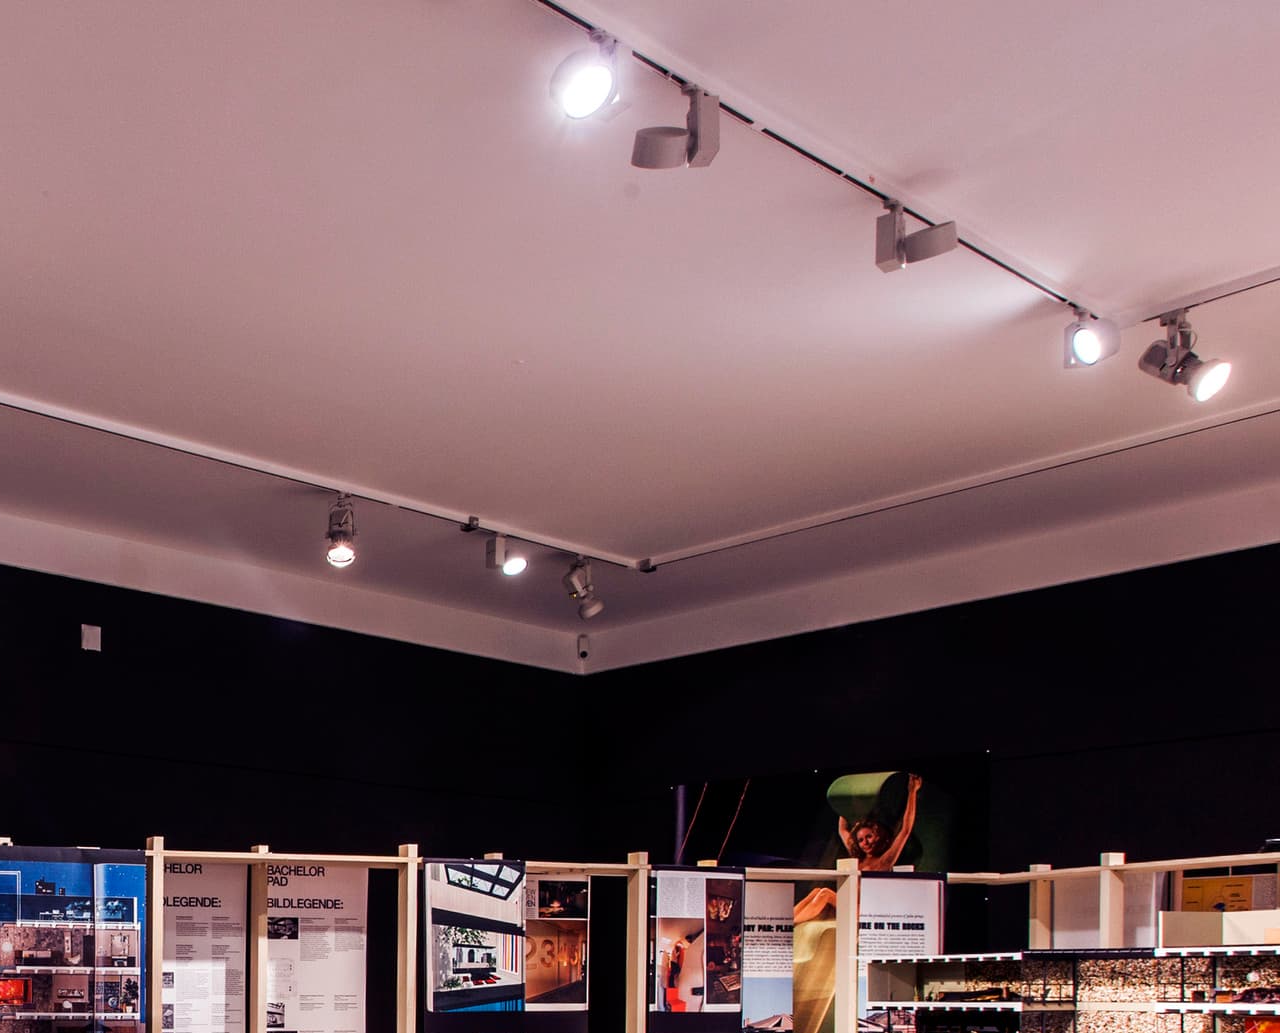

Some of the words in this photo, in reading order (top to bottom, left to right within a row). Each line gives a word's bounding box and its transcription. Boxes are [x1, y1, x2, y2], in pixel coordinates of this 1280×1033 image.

[164, 863, 202, 874] HELOR
[267, 865, 325, 876] BACHELOR
[267, 876, 288, 886] PAD
[163, 896, 221, 908] LEGENDE:
[267, 898, 344, 909] BILDLEGENDE:
[887, 922, 900, 930] THE
